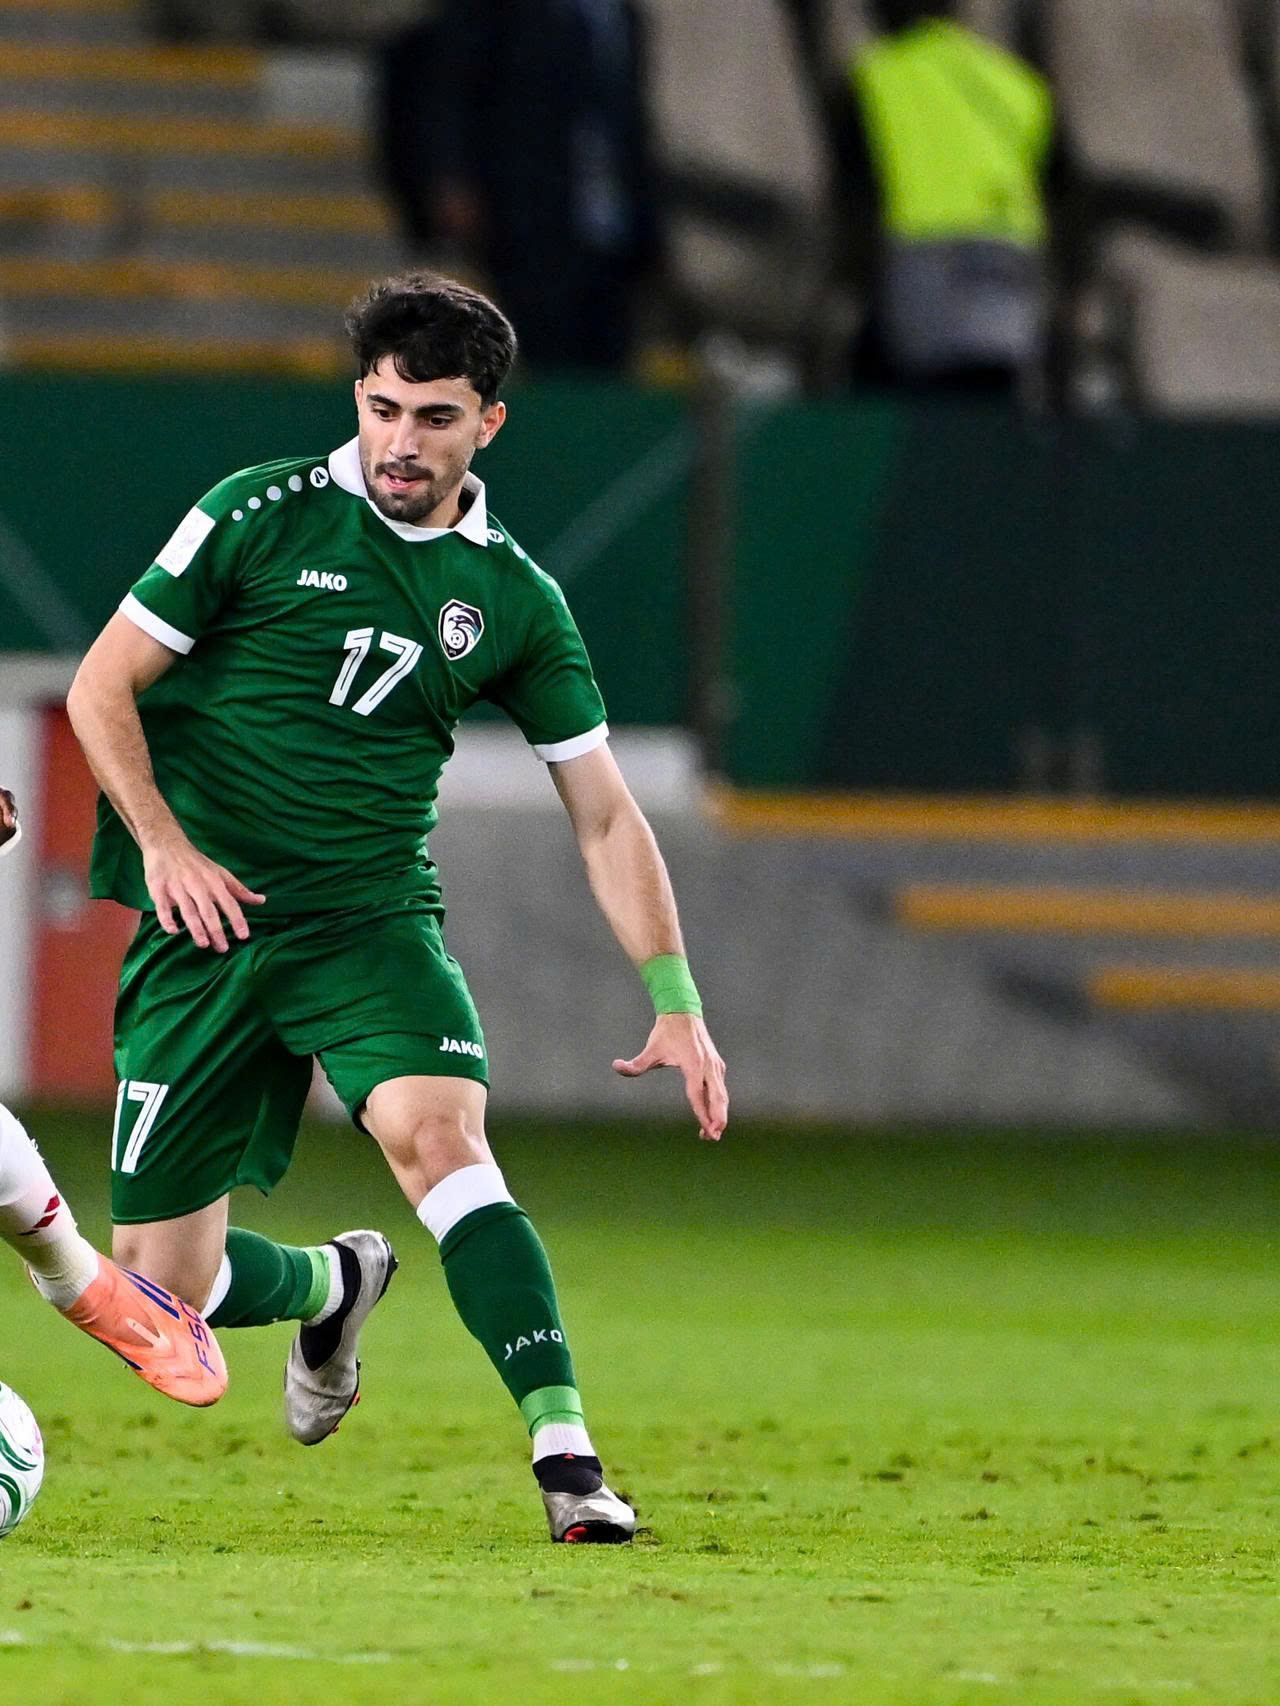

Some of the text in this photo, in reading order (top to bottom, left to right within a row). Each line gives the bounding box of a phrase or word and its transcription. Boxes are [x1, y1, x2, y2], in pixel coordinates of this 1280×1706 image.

[296, 569, 348, 592] JAKO
[328, 626, 424, 716] 17
[439, 1036, 483, 1059] JAKO
[504, 1329, 563, 1360] JAKO
